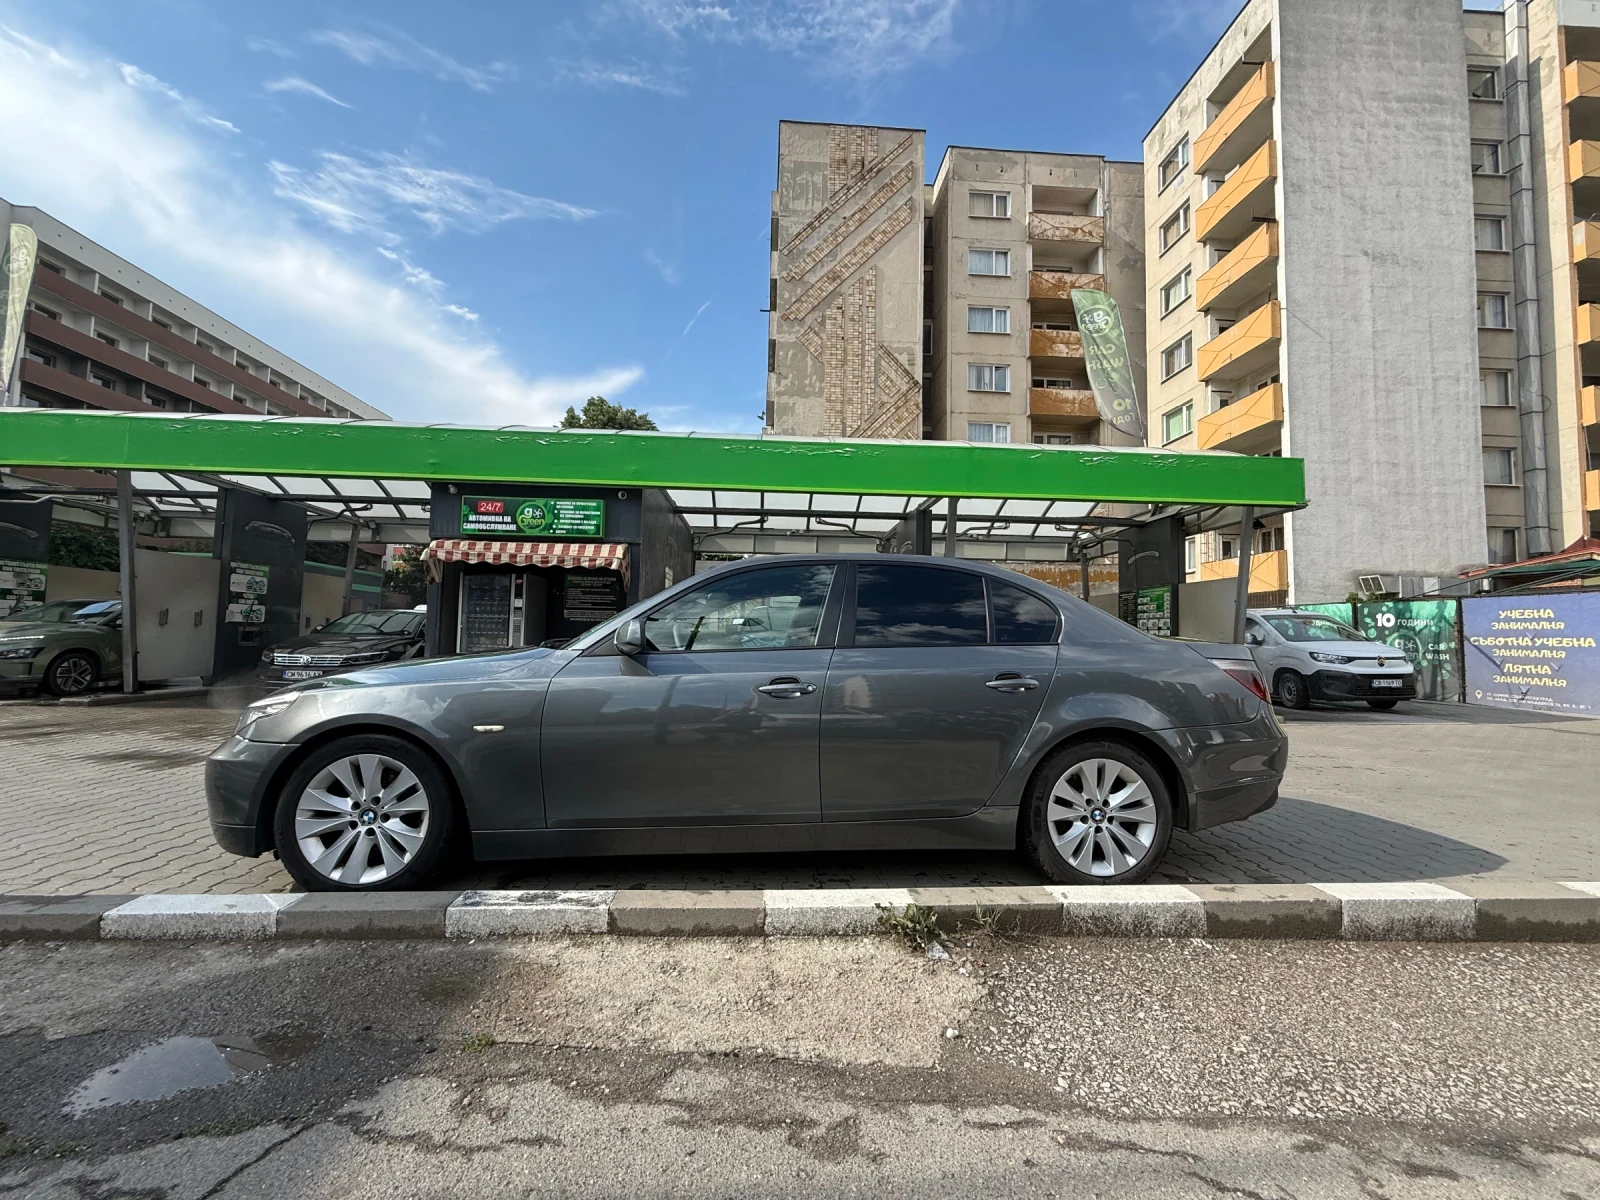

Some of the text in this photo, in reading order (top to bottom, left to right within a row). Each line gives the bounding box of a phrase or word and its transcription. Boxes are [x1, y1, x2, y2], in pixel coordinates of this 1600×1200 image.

[480, 502, 502, 511] 24/7
[468, 514, 512, 523] АВТОМИВКА НА
[518, 514, 545, 526] Green
[462, 522, 517, 531] САМООБСЛУЖВАНЕ
[1499, 609, 1554, 619] УЧЕБНА
[1376, 613, 1395, 627] 10
[1491, 621, 1565, 630] ЗАНИМАЛНЯ
[1428, 643, 1446, 651] CAR
[1469, 636, 1597, 648] СЪБОТНА УЧЕБНА
[1425, 652, 1450, 660] WASH
[1491, 648, 1566, 659] ЗАНИМАЛНЯ
[1504, 663, 1551, 674] ЛЯТНА
[1493, 675, 1567, 687] ЗАНИМАЛНЯ
